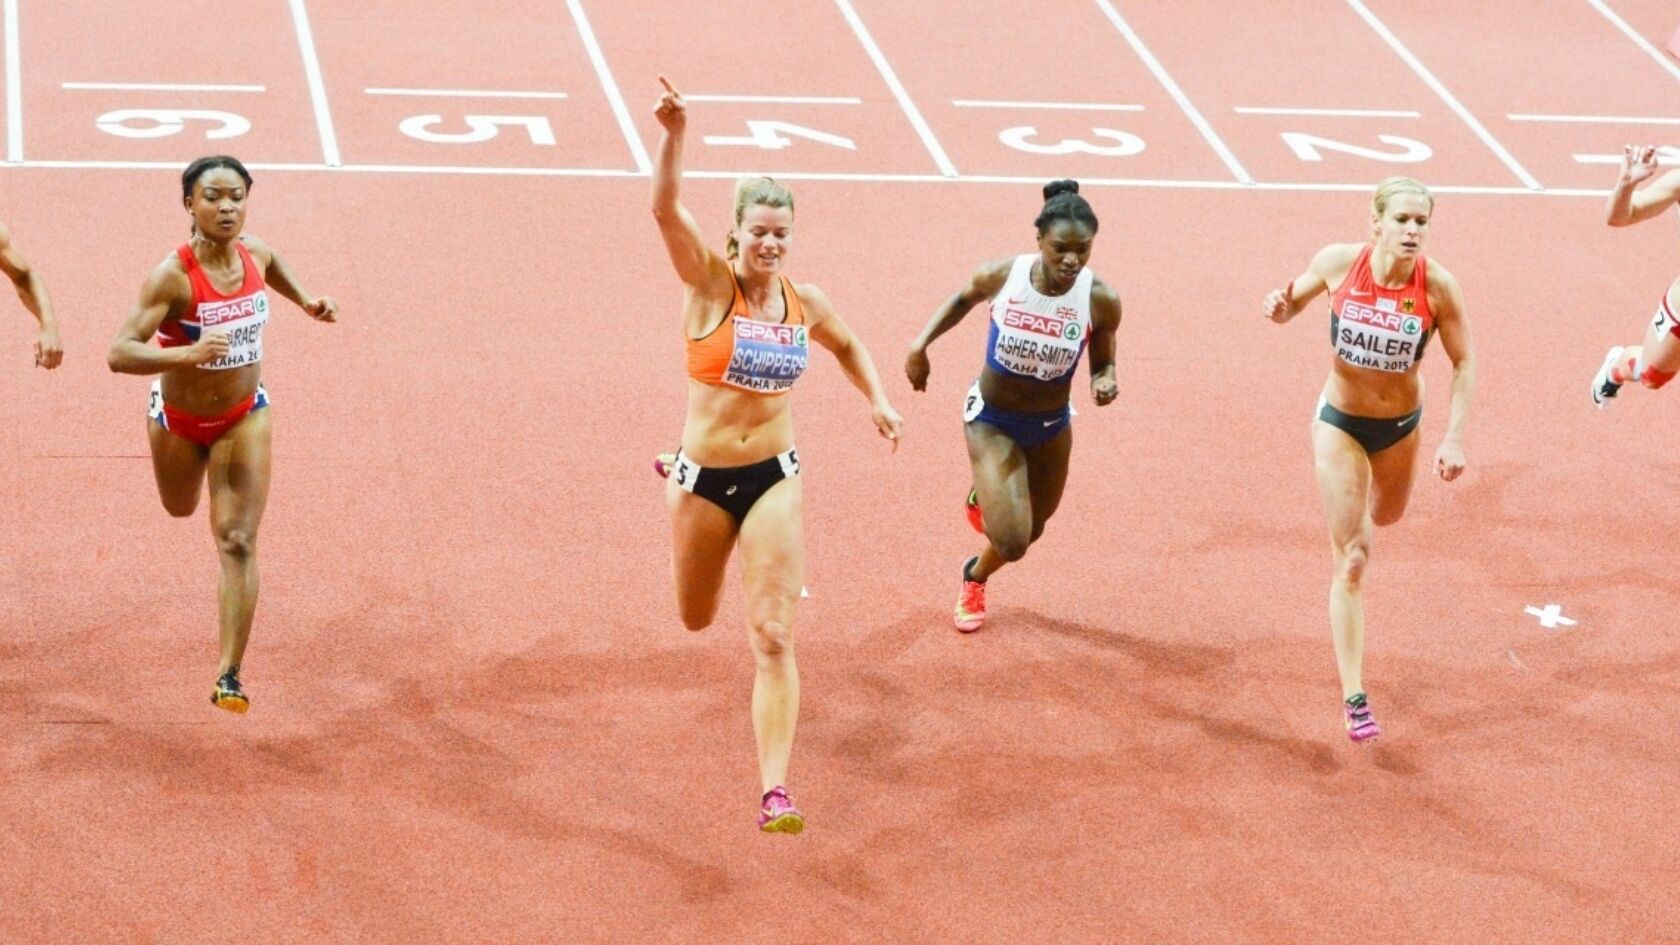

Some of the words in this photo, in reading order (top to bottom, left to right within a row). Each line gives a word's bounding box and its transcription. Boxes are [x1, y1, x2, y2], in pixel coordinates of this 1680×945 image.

[95, 109, 252, 139] 6
[399, 114, 557, 146] 5
[703, 120, 857, 150] 4
[998, 126, 1146, 156] 3
[1280, 132, 1433, 162] 2
[202, 300, 254, 325] SPAR
[1004, 309, 1062, 337] SPAR
[1343, 303, 1400, 332] SPAR
[737, 323, 792, 345] SPAR
[1341, 328, 1413, 356] SAILER
[731, 347, 807, 376] SCHIPPERS
[997, 335, 1079, 366] ASHER-SMITH
[1338, 348, 1380, 368] PRAHA
[1384, 361, 1409, 372] 2015
[727, 373, 769, 390] PRAHA
[677, 462, 688, 485] 5
